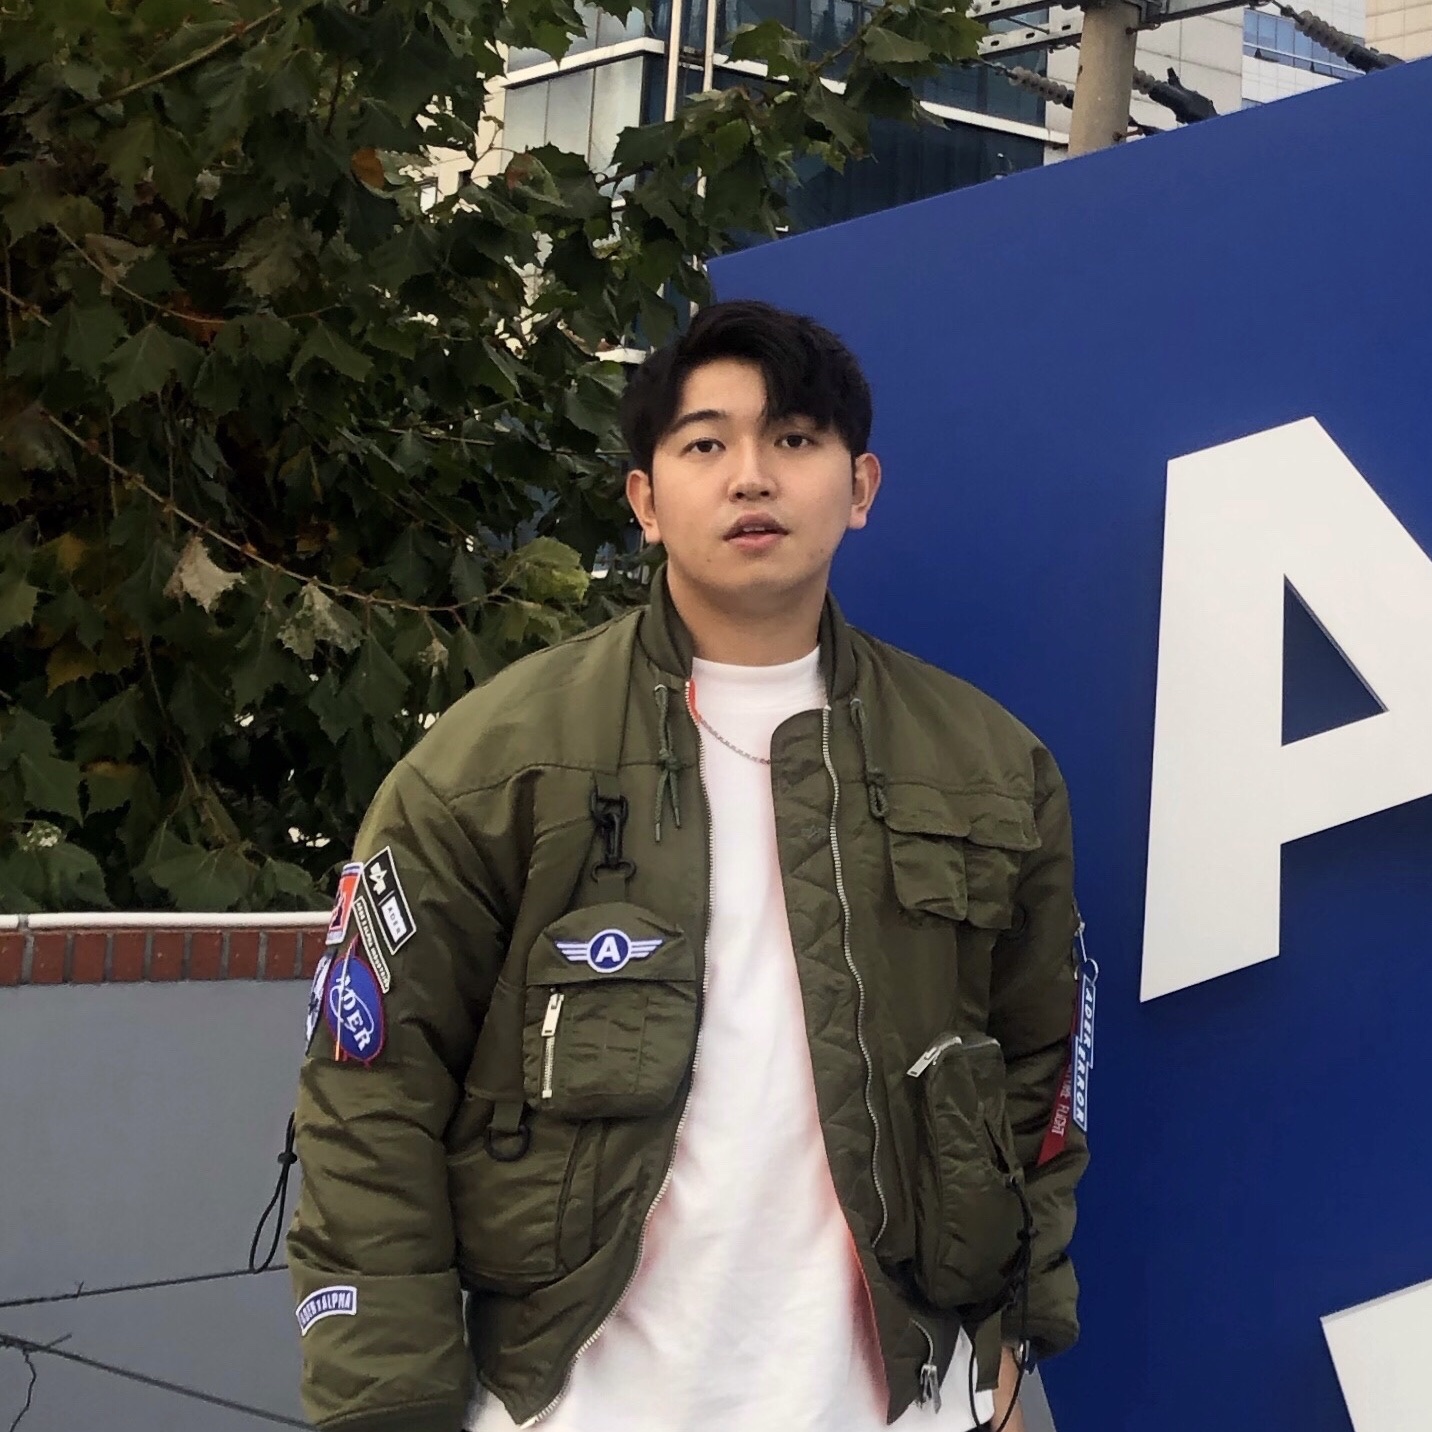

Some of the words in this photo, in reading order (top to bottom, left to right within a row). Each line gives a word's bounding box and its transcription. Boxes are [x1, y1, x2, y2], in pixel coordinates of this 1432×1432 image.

[595, 936, 621, 963] A
[1083, 987, 1093, 1048] ADER
[1076, 1044, 1087, 1122] ERROR
